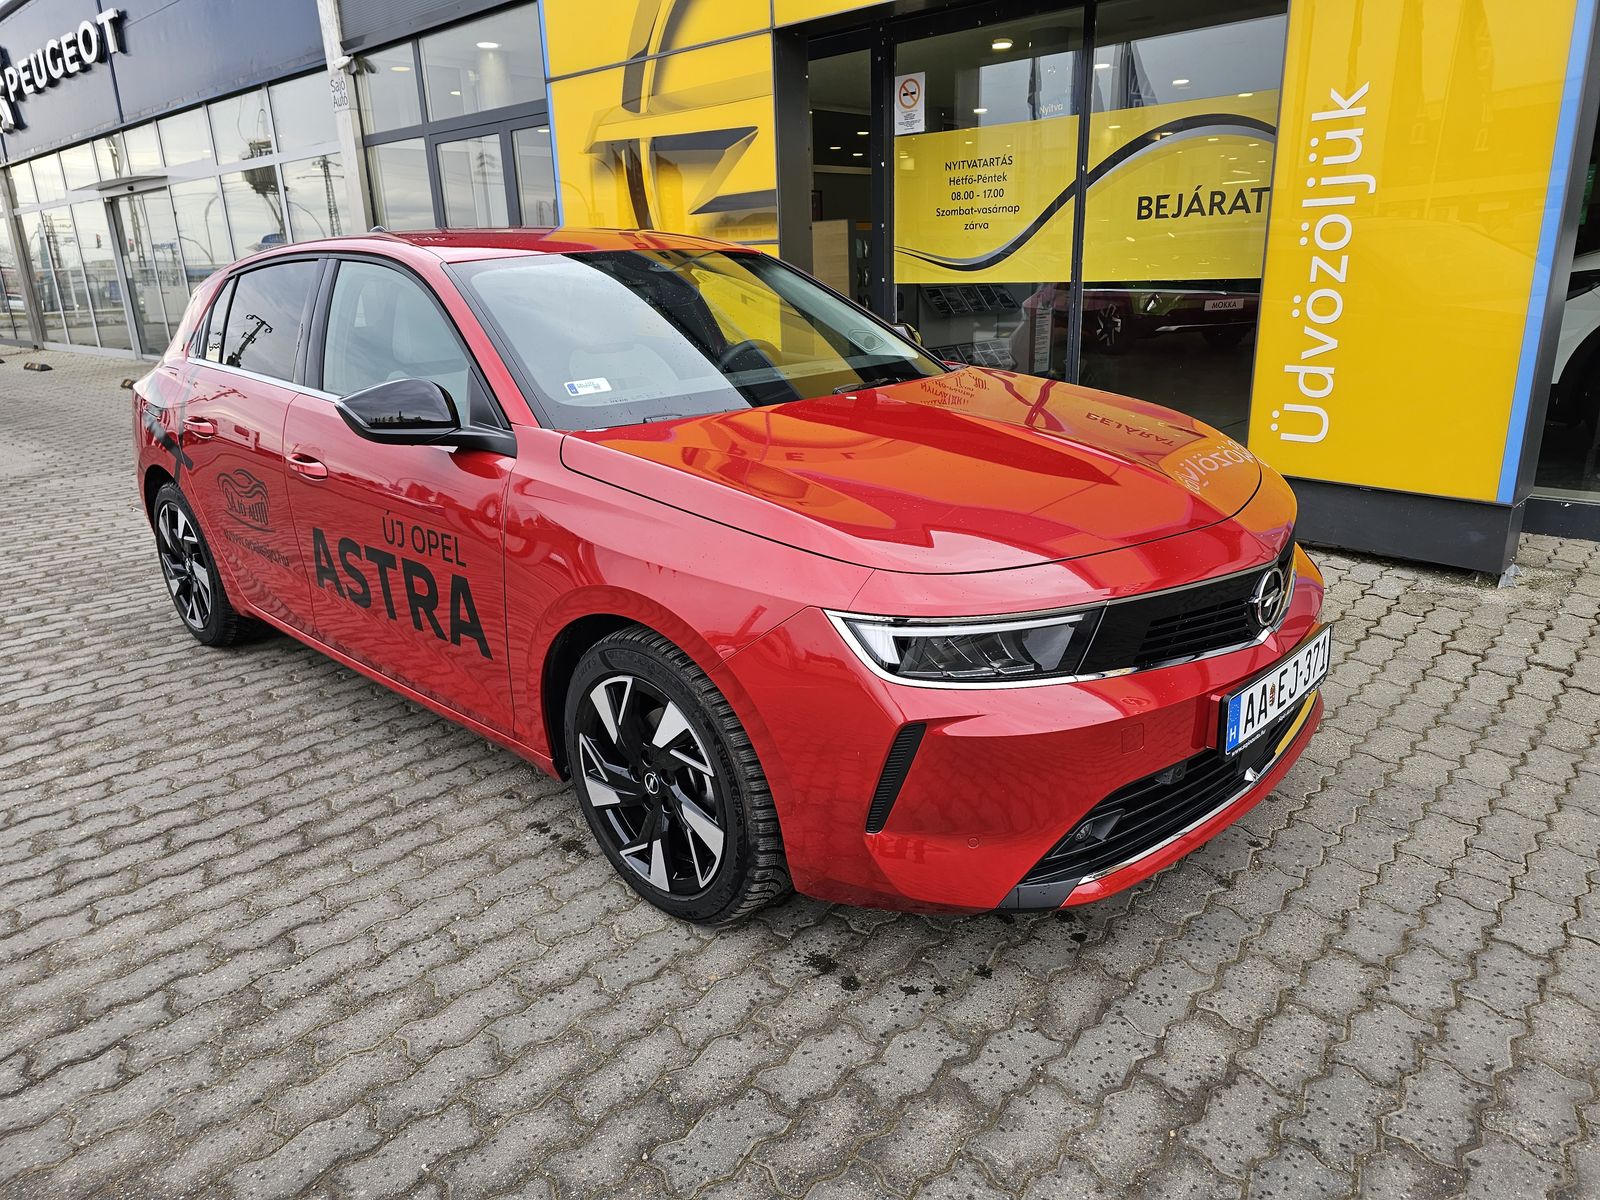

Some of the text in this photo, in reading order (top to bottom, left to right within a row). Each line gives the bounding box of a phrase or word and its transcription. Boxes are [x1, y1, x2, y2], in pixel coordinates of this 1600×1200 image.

[4, 8, 119, 103] PEUGEOT
[944, 154, 1013, 171] NYITVATARTÁS
[935, 204, 1020, 217] Szombat-vasárnap
[951, 190, 974, 201] 08.00
[983, 188, 1004, 199] 17.00
[1136, 184, 1271, 220] BEJÁRAT
[964, 221, 989, 231] zárva
[1270, 81, 1376, 443] Üdvözöljük
[1211, 301, 1237, 309] MOKKA
[381, 509, 467, 568] ÚJ OPEL
[312, 527, 494, 661] ASTRA
[1243, 635, 1327, 735] AA EJ-371
